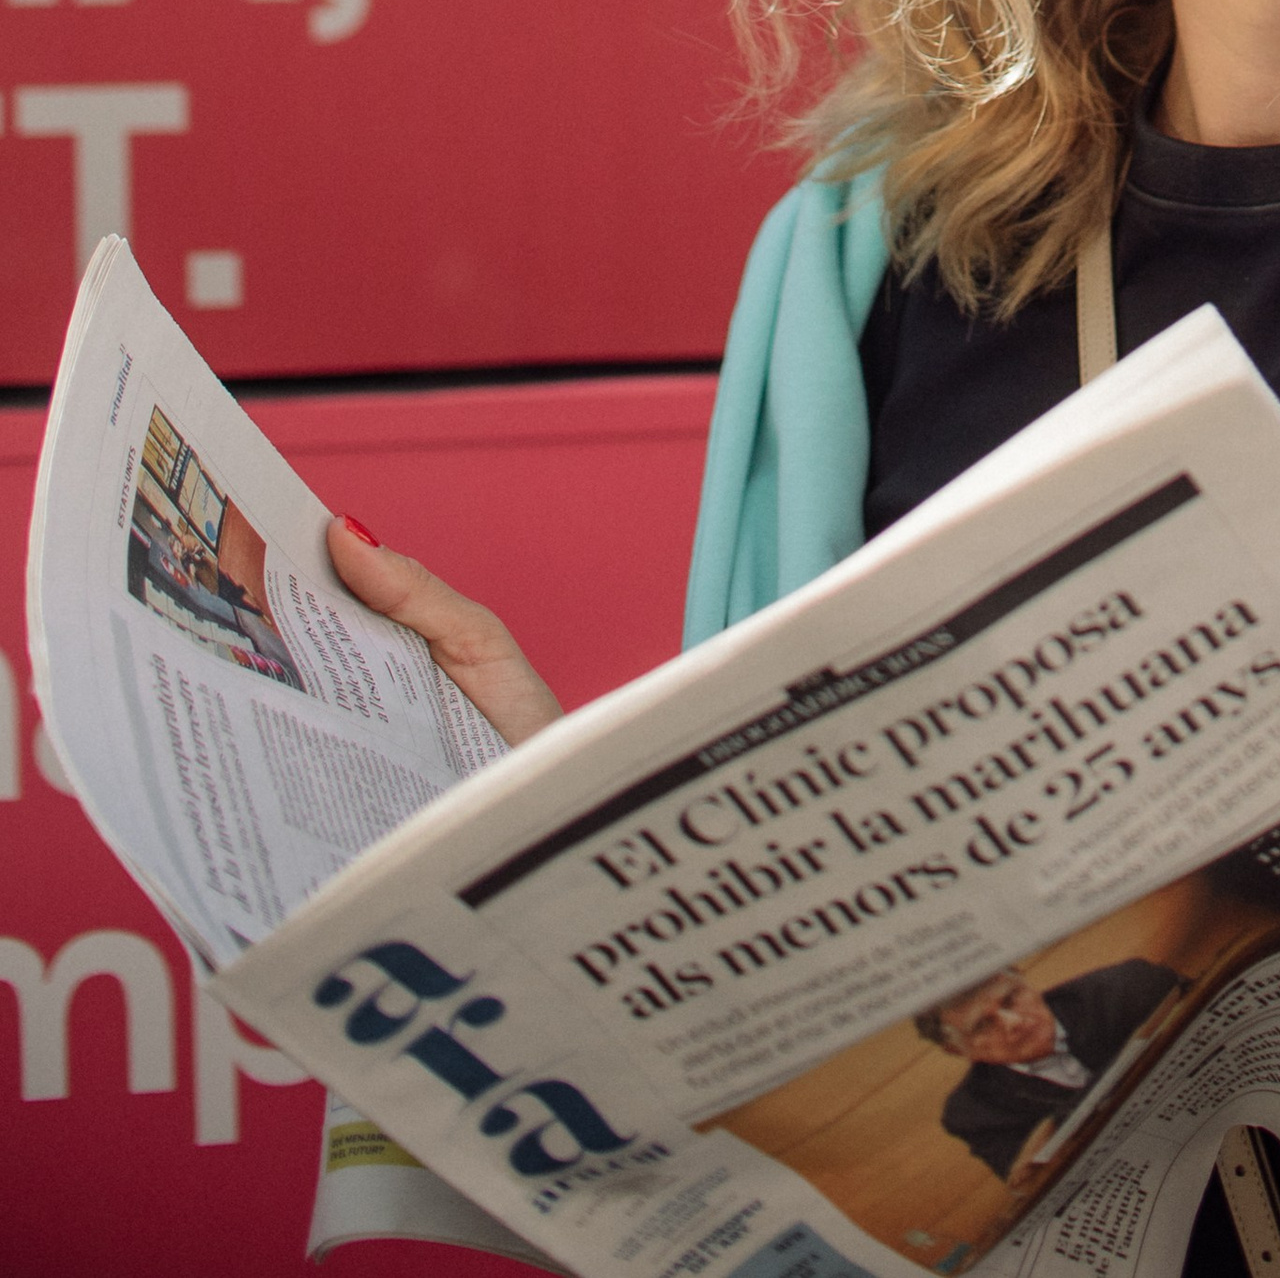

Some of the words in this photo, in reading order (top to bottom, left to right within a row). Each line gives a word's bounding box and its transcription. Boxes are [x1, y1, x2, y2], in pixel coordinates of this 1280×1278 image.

[0, 81, 243, 310] T.
[110, 353, 133, 426] actualitat
[117, 483, 130, 529] ESTATS
[124, 447, 136, 482] UNITS
[288, 573, 302, 605] una
[304, 591, 322, 616] ara
[295, 606, 311, 625] en
[325, 605, 352, 643] Maine
[304, 626, 333, 664] morts
[316, 619, 355, 674] matança,
[349, 647, 366, 665] de
[324, 664, 353, 712] Divuit
[346, 679, 371, 719] doble
[356, 665, 385, 711] l'estat
[444, 681, 455, 691] el
[449, 691, 459, 704] En
[152, 653, 201, 800] preparatòria
[178, 677, 211, 770] terrestre
[377, 712, 389, 724] a
[451, 706, 465, 727] local.
[468, 721, 482, 747] edició
[459, 727, 470, 747] hora
[488, 747, 497, 758] La
[592, 829, 677, 889] El
[677, 743, 867, 847] Clínic
[881, 592, 1142, 770] proposa
[465, 748, 477, 771] tarda,
[201, 773, 235, 855] invasió
[573, 847, 823, 987] prohibir
[830, 811, 906, 854] la
[909, 602, 1258, 816] marihuana
[622, 963, 714, 1020] als
[717, 864, 959, 977] menors
[966, 813, 1038, 867] de
[1043, 743, 1135, 822] 25
[312, 939, 643, 1178] ara
[1055, 1215, 1077, 1256] ERC
